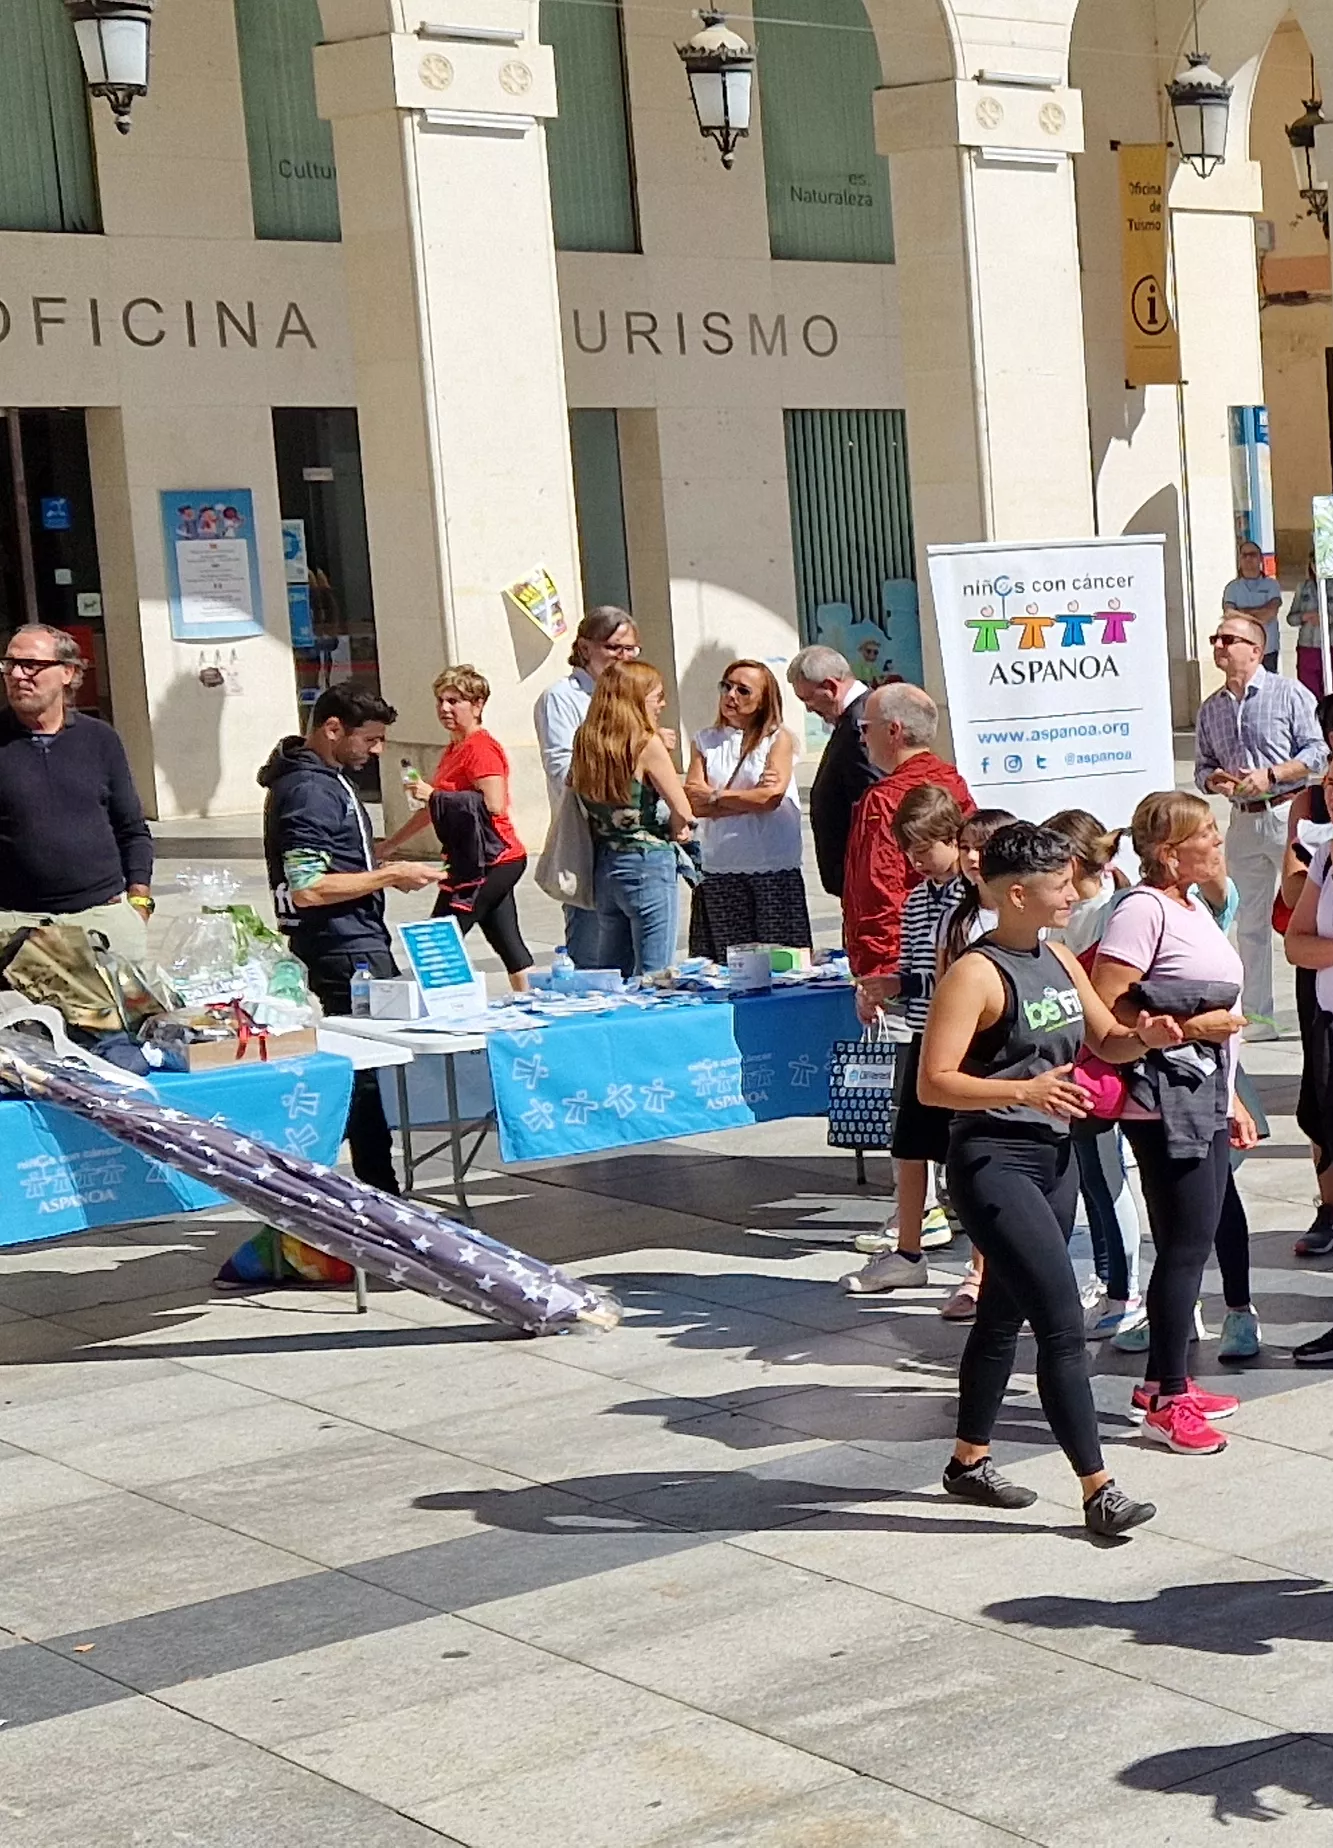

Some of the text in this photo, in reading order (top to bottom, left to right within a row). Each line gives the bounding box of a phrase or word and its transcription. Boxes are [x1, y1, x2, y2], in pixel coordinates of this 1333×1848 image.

[790, 186, 873, 208] Naturaleza
[0, 297, 317, 348] FICINA
[573, 309, 838, 357] URISMO
[1032, 577, 1066, 593] con
[1072, 573, 1134, 591] cáncer
[989, 655, 1120, 686] ASPANOA
[977, 721, 1130, 744] www.aspanoa.org
[1064, 750, 1132, 765] @aspanoa
[38, 1188, 116, 1214] ASPANOA
